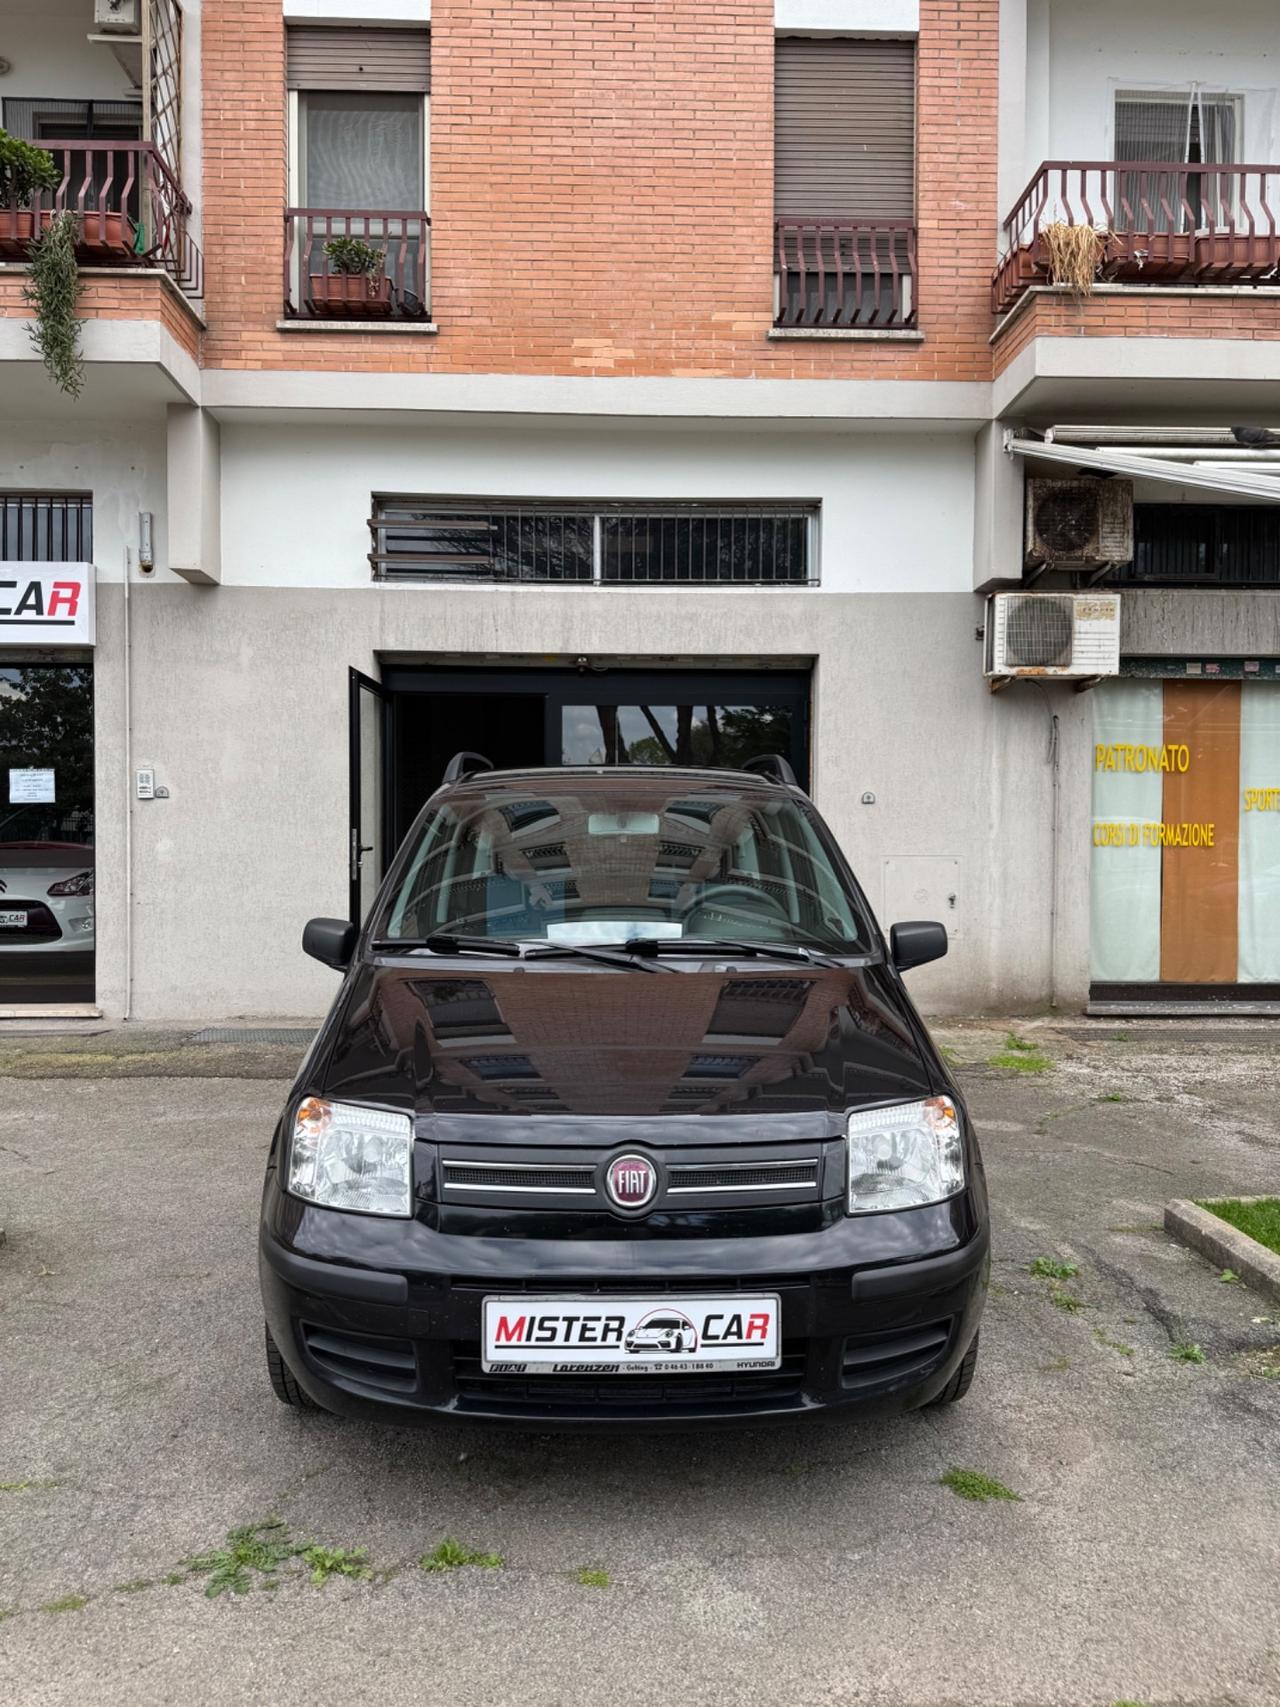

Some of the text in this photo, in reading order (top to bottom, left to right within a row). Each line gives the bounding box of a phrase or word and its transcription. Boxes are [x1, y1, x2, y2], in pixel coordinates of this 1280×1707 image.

[1095, 744, 1190, 773] PATRONATO
[1093, 823, 1215, 847] CORSI DI FORMAZIONE
[618, 1170, 647, 1194] FIAT
[495, 1313, 771, 1343] MISTER CAR
[736, 1360, 776, 1369] HYUNDAI
